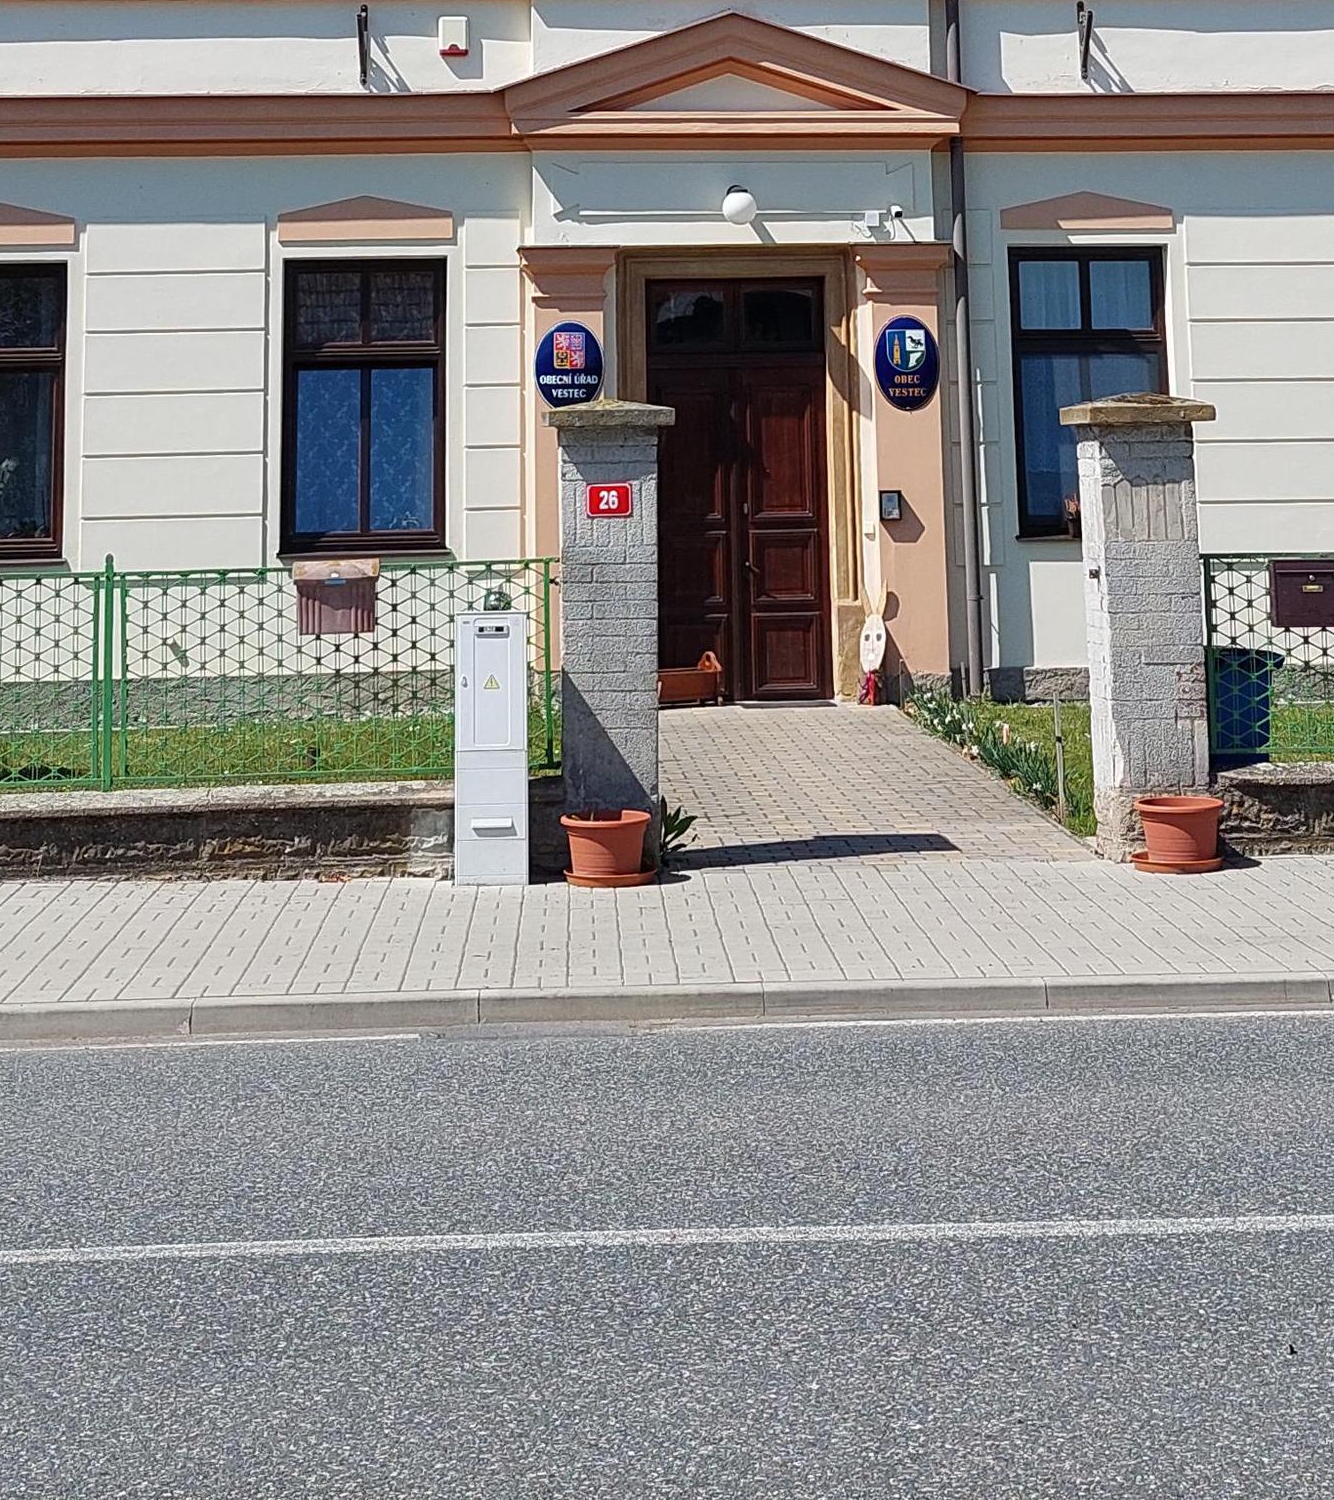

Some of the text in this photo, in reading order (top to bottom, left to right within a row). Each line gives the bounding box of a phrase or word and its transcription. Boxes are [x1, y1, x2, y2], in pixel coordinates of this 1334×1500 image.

[539, 373, 599, 385] OBECNÍ ÚŘAD
[894, 374, 921, 384] OBEC
[551, 388, 587, 398] VESTEC
[888, 387, 927, 397] VESTEC
[599, 490, 619, 510] 26
